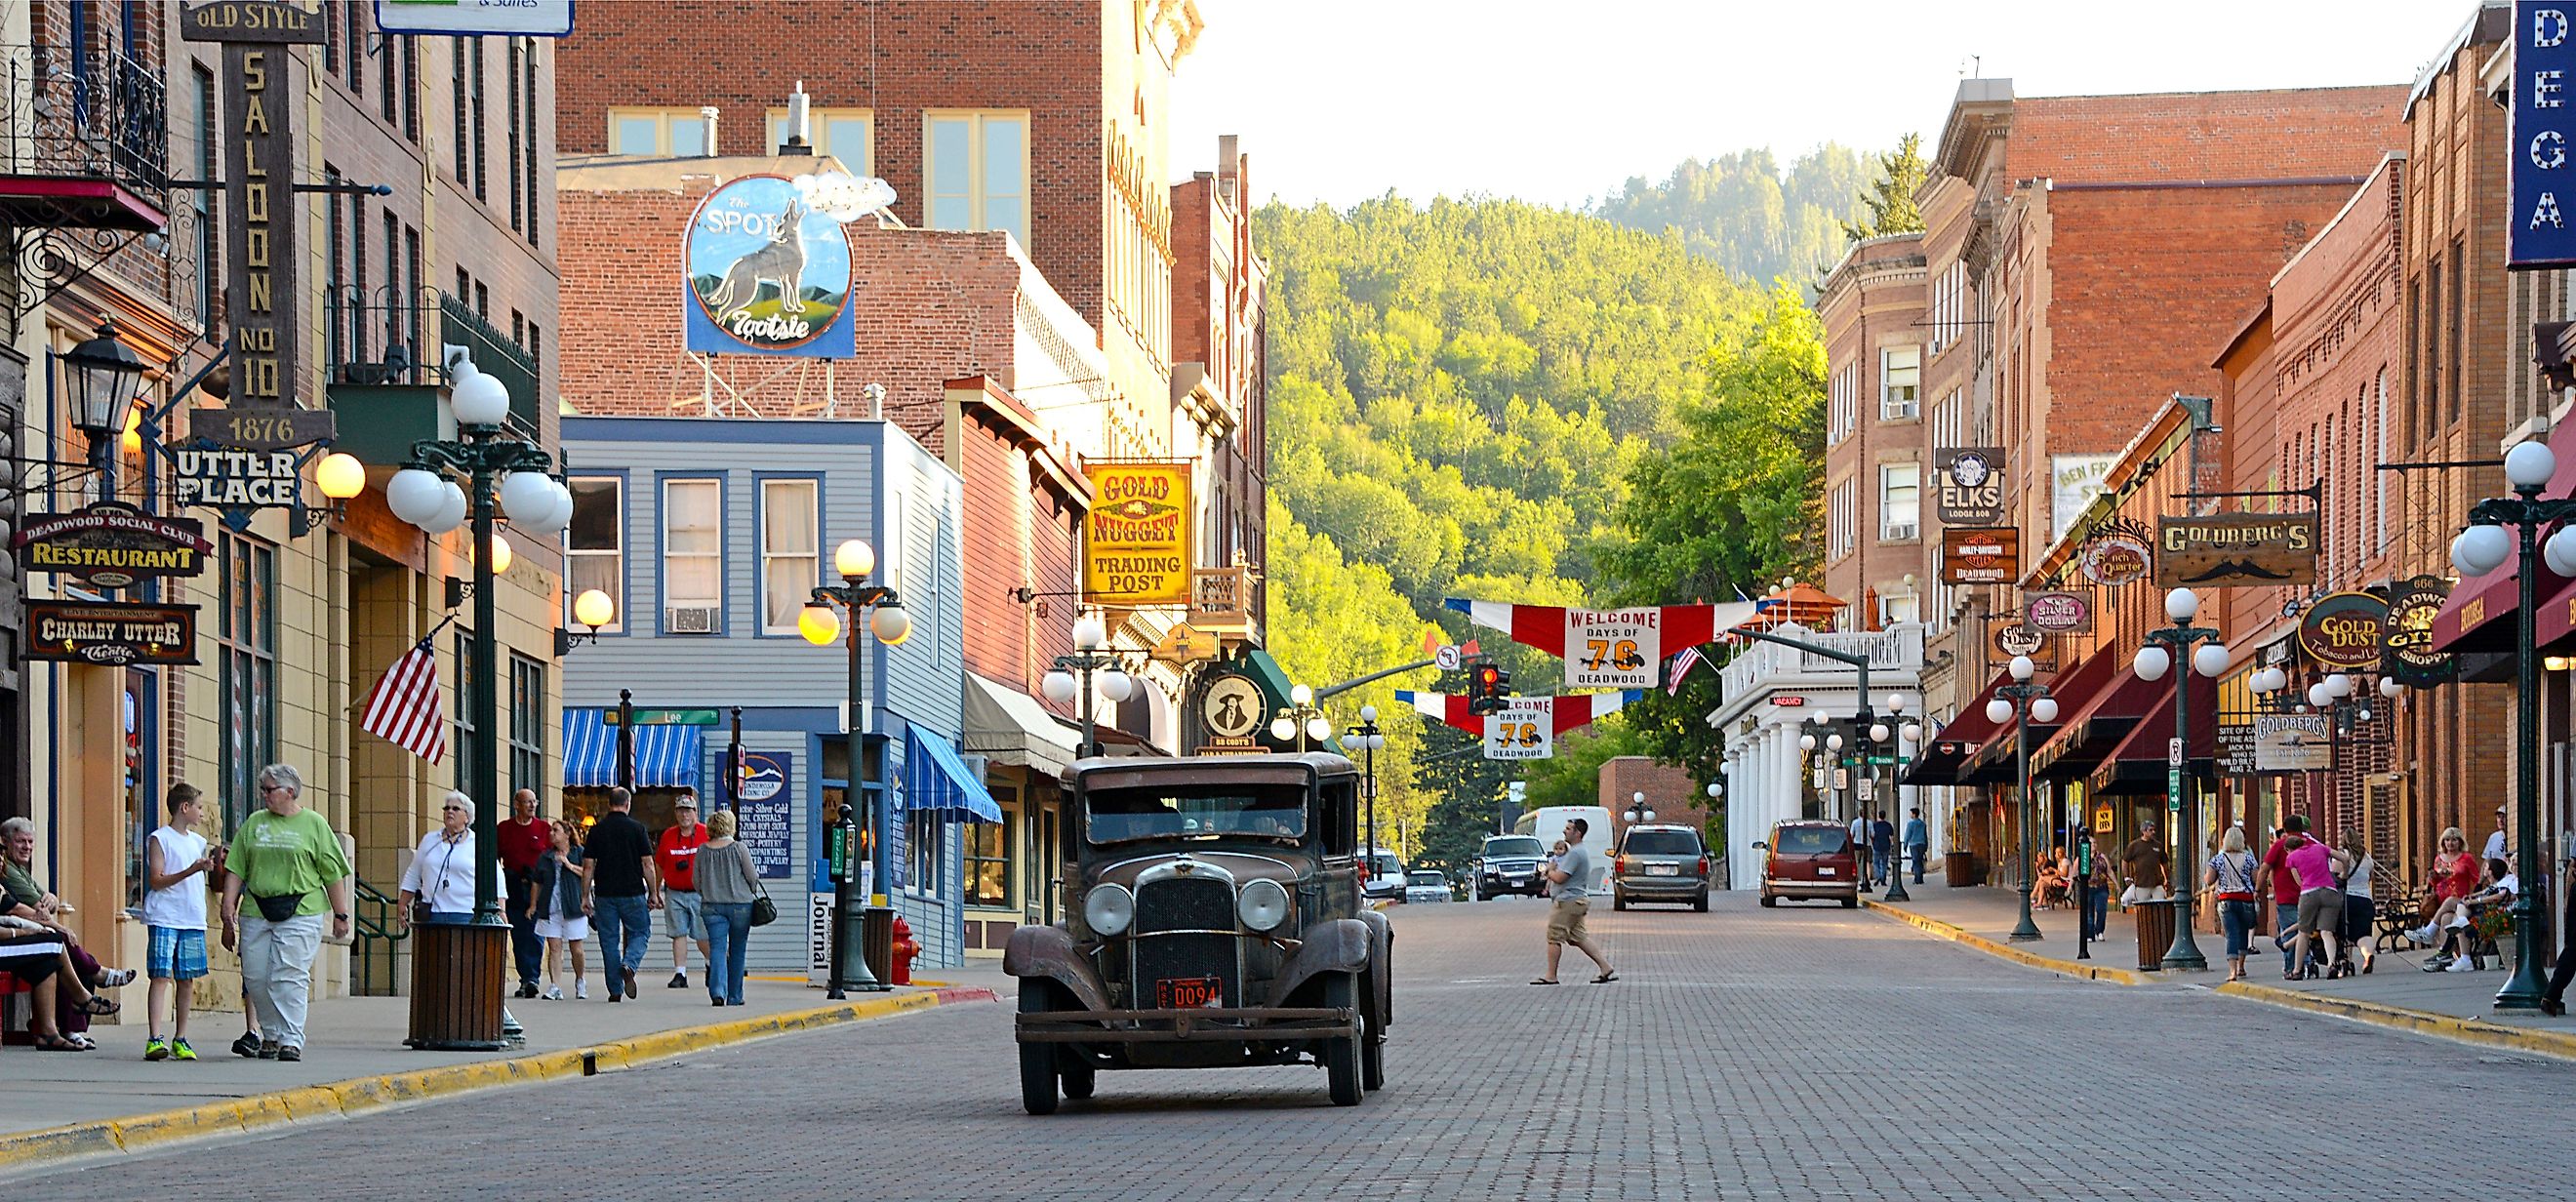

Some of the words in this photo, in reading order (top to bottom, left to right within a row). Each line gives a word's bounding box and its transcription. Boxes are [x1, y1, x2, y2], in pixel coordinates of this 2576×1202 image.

[197, 6, 238, 28] OLD
[245, 4, 308, 30] STYLE
[2530, 10, 2568, 230] DEGA
[243, 51, 273, 313] SALOON
[729, 196, 749, 209] The
[704, 209, 778, 236] SPOT
[733, 310, 810, 344] Tootsie
[239, 328, 275, 352] NO
[243, 357, 279, 397] 10
[228, 418, 295, 442] 1876
[177, 451, 297, 478] UTTER
[2091, 461, 2109, 476] FR
[177, 478, 295, 505] PLACE
[1104, 475, 1170, 501] GOLD
[1942, 487, 1998, 508] ELKS
[1949, 509, 1973, 518] LODGE
[26, 516, 104, 540] DEADWOOD
[108, 516, 157, 533] SOCIAL
[160, 526, 196, 545] CLUB
[1094, 512, 1179, 543] NUGGET
[2164, 520, 2310, 552] GOLDBERG'S
[32, 542, 194, 569] RESTAURANT
[1958, 544, 2002, 555] HARLEY-DAVIDSON
[1095, 557, 1181, 574] TRADING
[1956, 568, 2004, 579] DEADWOOD
[2103, 562, 2143, 577] Quarter
[1108, 575, 1164, 591] POST
[2413, 579, 2434, 589] 666
[1570, 611, 1657, 629] WELCOME
[2037, 605, 2076, 616] SILVER
[2037, 616, 2078, 625] DOLLAR
[2387, 592, 2447, 626] DEADWO
[41, 618, 116, 641] CHARLEY
[124, 621, 181, 646] UTTER
[1587, 628, 1620, 637] DAYS
[1624, 628, 1639, 637] OF
[2320, 617, 2377, 635] GOLD
[2311, 638, 2349, 661] Tobacco
[2349, 649, 2365, 661] and
[2332, 632, 2381, 648] DUST
[1587, 639, 1638, 671] 76
[1578, 674, 1646, 684] DEADWOOD
[1508, 700, 1550, 714] LCOME
[1773, 697, 1802, 705] VACANCY
[664, 711, 682, 723] Lee
[1500, 723, 1538, 748] 76
[814, 896, 828, 970] Journal
